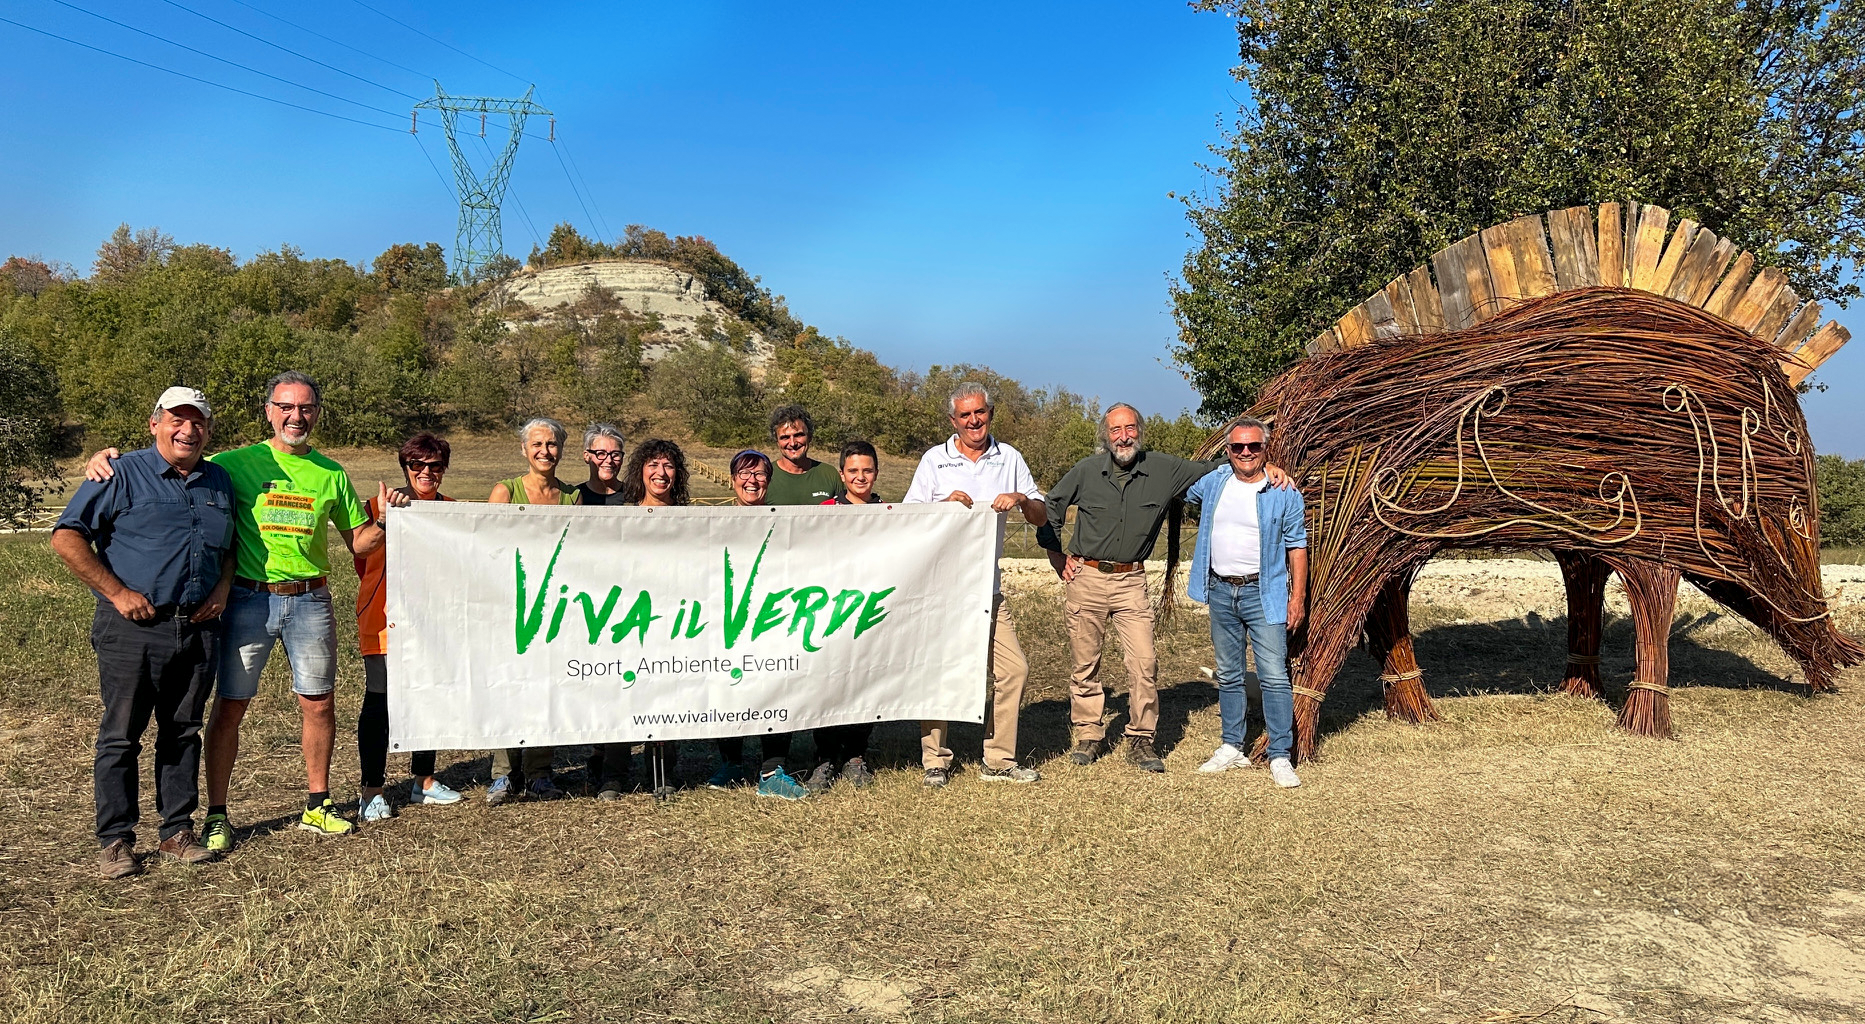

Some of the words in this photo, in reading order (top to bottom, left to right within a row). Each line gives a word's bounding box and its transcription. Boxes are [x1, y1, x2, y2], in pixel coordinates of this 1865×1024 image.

[275, 500, 312, 510] FRANCESCO
[742, 653, 800, 673] Eventi
[632, 707, 788, 726] www.vivailverde.org
